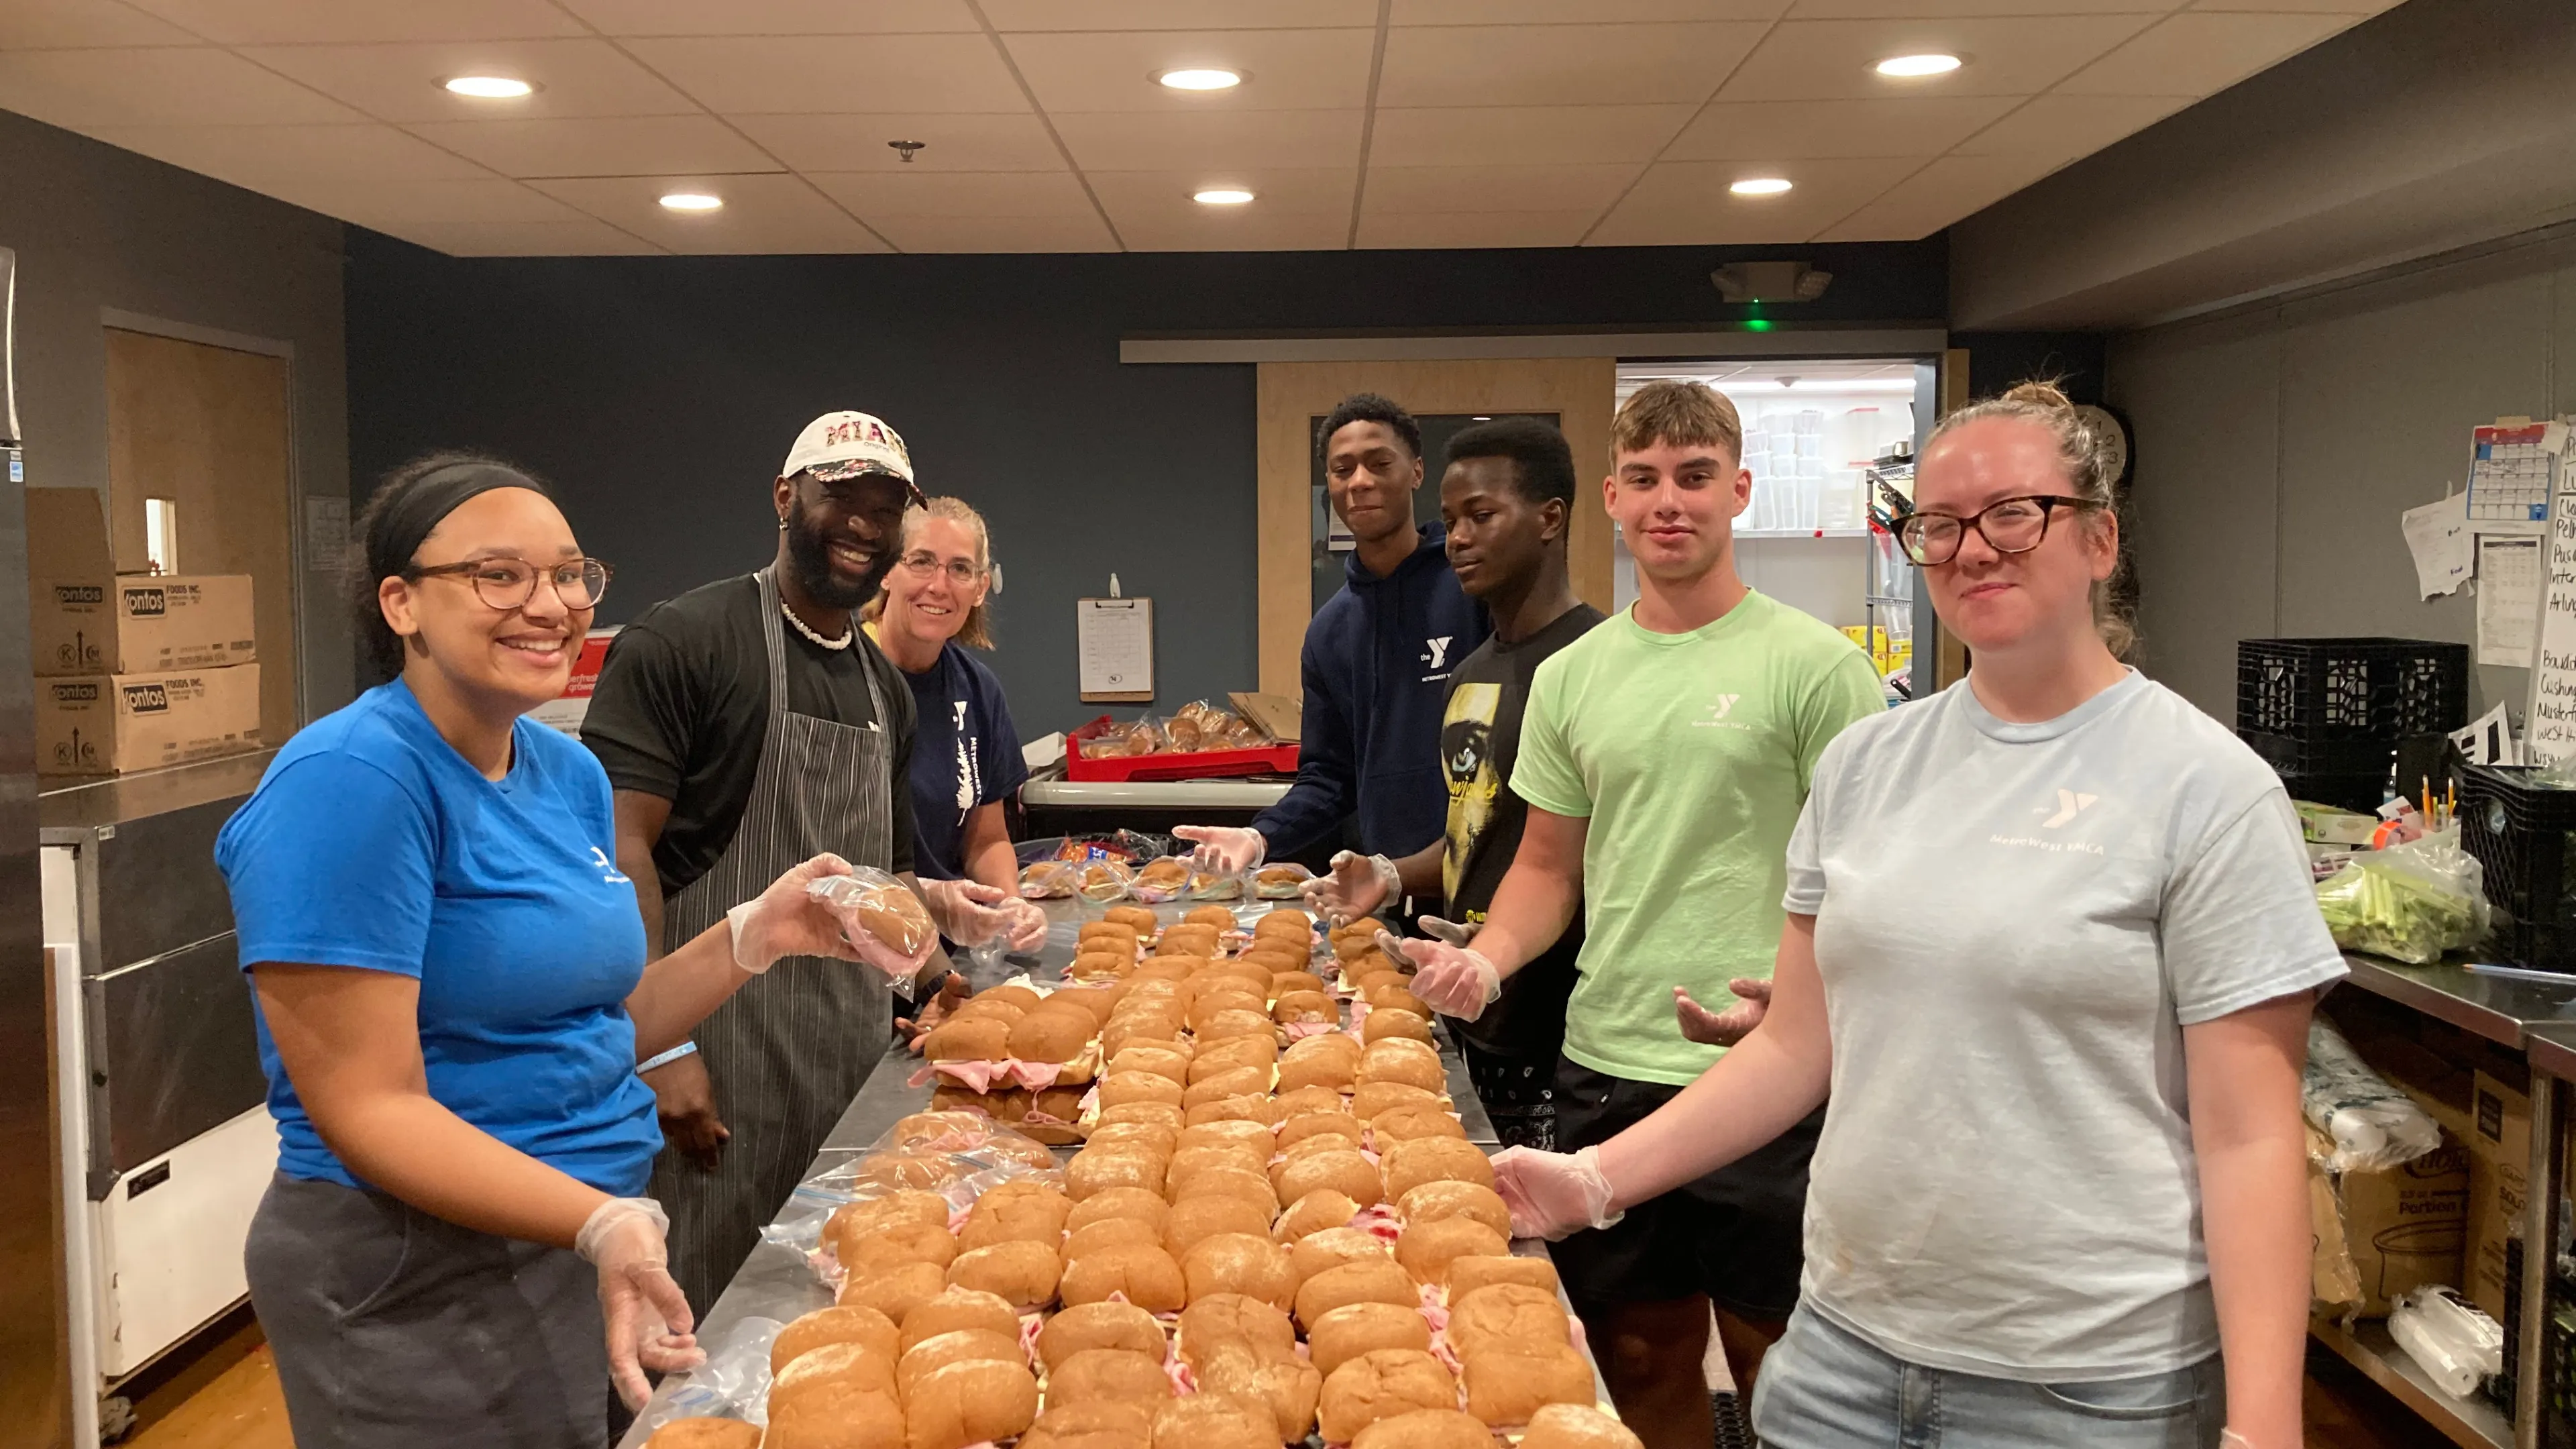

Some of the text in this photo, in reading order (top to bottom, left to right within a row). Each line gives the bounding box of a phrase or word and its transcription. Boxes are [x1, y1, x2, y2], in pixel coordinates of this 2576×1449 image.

[2106, 434, 2116, 447] 2
[2108, 451, 2118, 465] 3
[166, 585, 188, 594] FOODS
[970, 737, 982, 796] METROWEST
[1989, 833, 2104, 856] MetroWest YMCA
[2400, 1201, 2457, 1215] Portion
